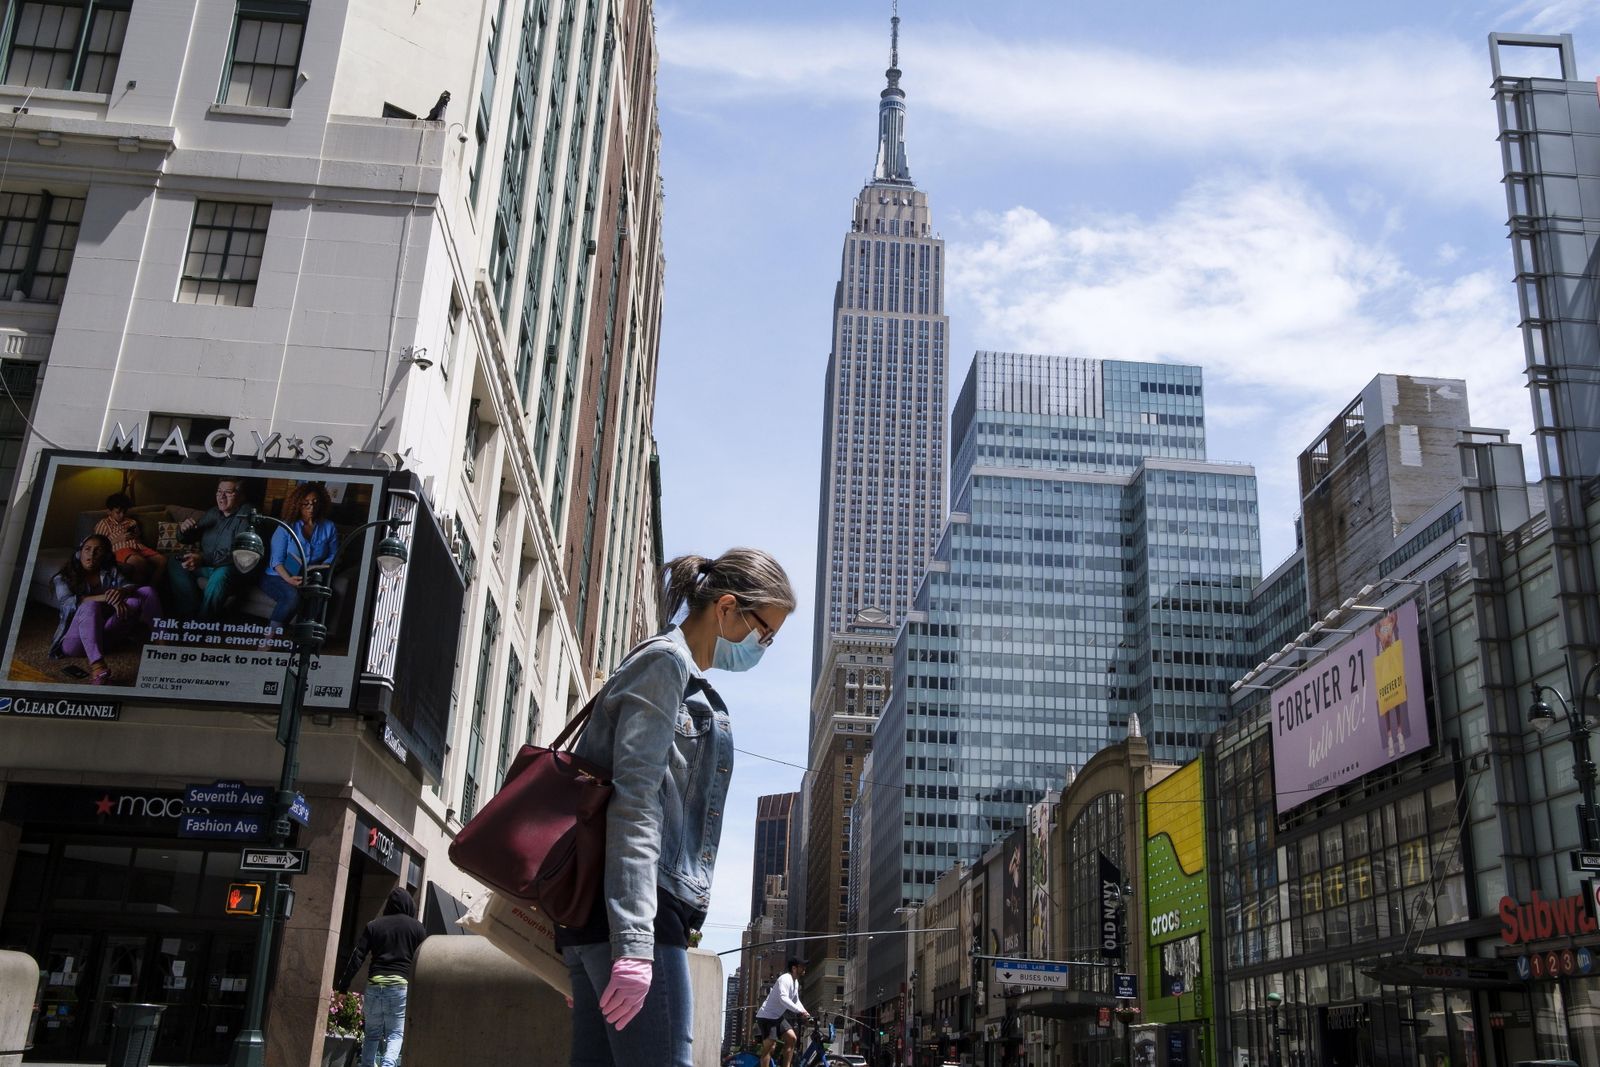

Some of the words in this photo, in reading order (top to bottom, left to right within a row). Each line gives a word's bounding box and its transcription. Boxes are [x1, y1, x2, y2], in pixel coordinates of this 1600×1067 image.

[152, 617, 179, 629] Talk
[182, 620, 220, 632] about
[223, 622, 273, 636] making
[275, 626, 284, 634] a
[150, 631, 180, 643] plan
[182, 632, 202, 642] for
[205, 634, 222, 644] an
[146, 649, 178, 661] Then
[180, 653, 197, 663] go
[200, 651, 231, 664] back
[235, 654, 248, 664] to
[251, 656, 273, 667] not
[275, 655, 322, 671] talkg.
[159, 677, 230, 687] NYC.GOV/READYNY
[265, 682, 277, 692] ad
[1278, 665, 1342, 737] FOREVER
[1348, 649, 1366, 694] 21
[1308, 720, 1333, 769] hello
[1336, 680, 1367, 745] NYC!
[117, 795, 210, 818] mac
[190, 789, 238, 804] Seventh
[240, 791, 264, 805] Ave
[186, 818, 232, 832] Fashion
[234, 820, 258, 833] Ave
[252, 854, 268, 863] ONE
[276, 856, 294, 865] WAY
[1103, 880, 1116, 919] NAVY
[1151, 909, 1180, 937] crocs
[1499, 889, 1598, 944] Subwa
[1103, 920, 1116, 950] OLD
[1533, 957, 1540, 974] 1
[1549, 956, 1557, 972] 2
[1563, 954, 1571, 970] 3
[1020, 973, 1042, 981] BUSES
[1043, 975, 1060, 983] ONLY
